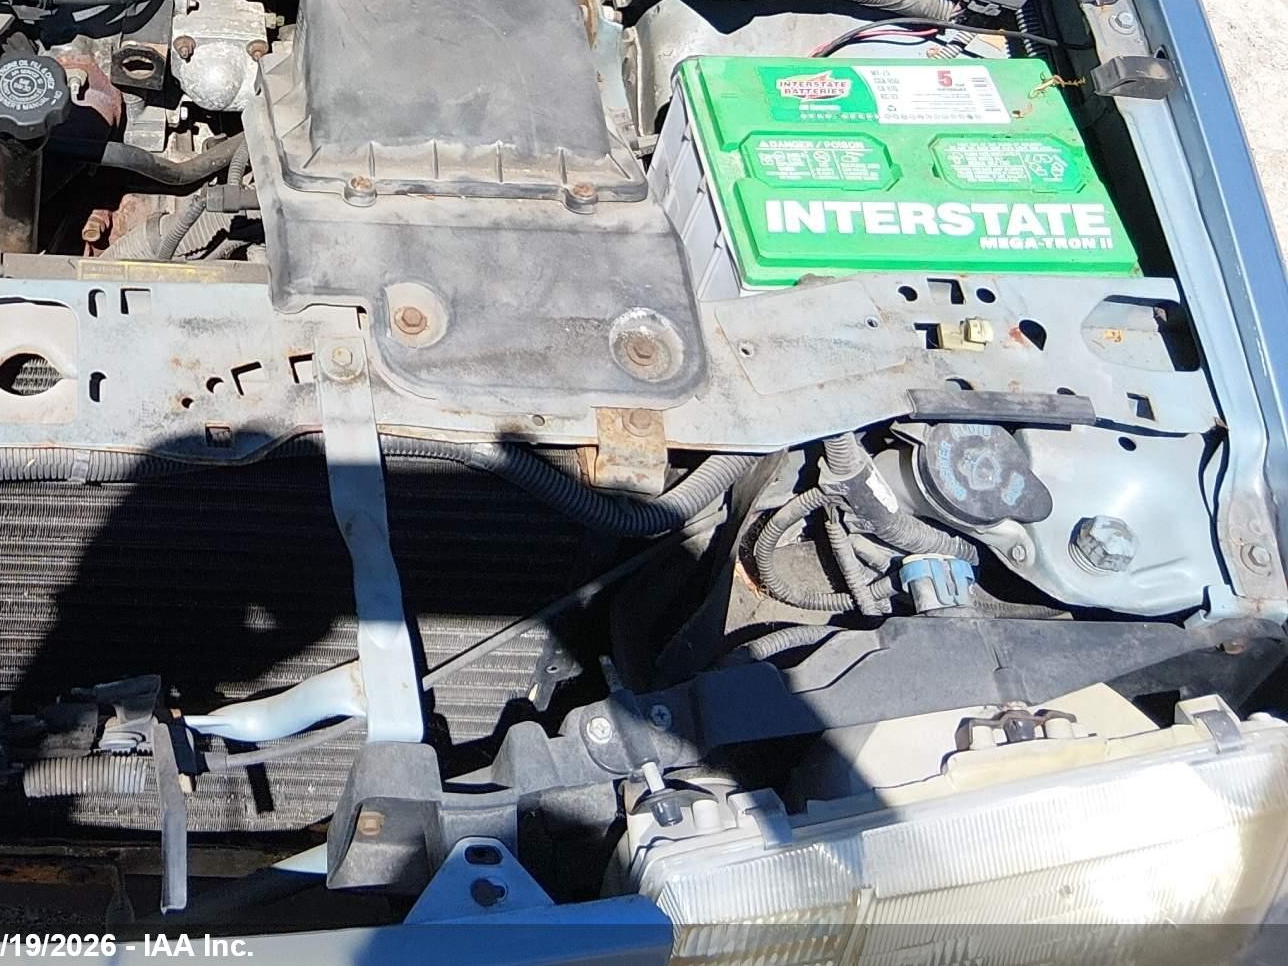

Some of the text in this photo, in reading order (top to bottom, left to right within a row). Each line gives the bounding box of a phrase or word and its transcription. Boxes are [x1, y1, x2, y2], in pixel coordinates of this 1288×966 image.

[18, 59, 28, 67] OIL
[30, 60, 42, 71] FILL
[778, 80, 848, 88] INTERSTATE
[937, 70, 953, 87] 5
[783, 87, 846, 95] BATTERIES
[768, 140, 814, 149] DANGER
[763, 199, 1113, 237] INTERSTATE
[979, 236, 1097, 250] MEGA-TRON
